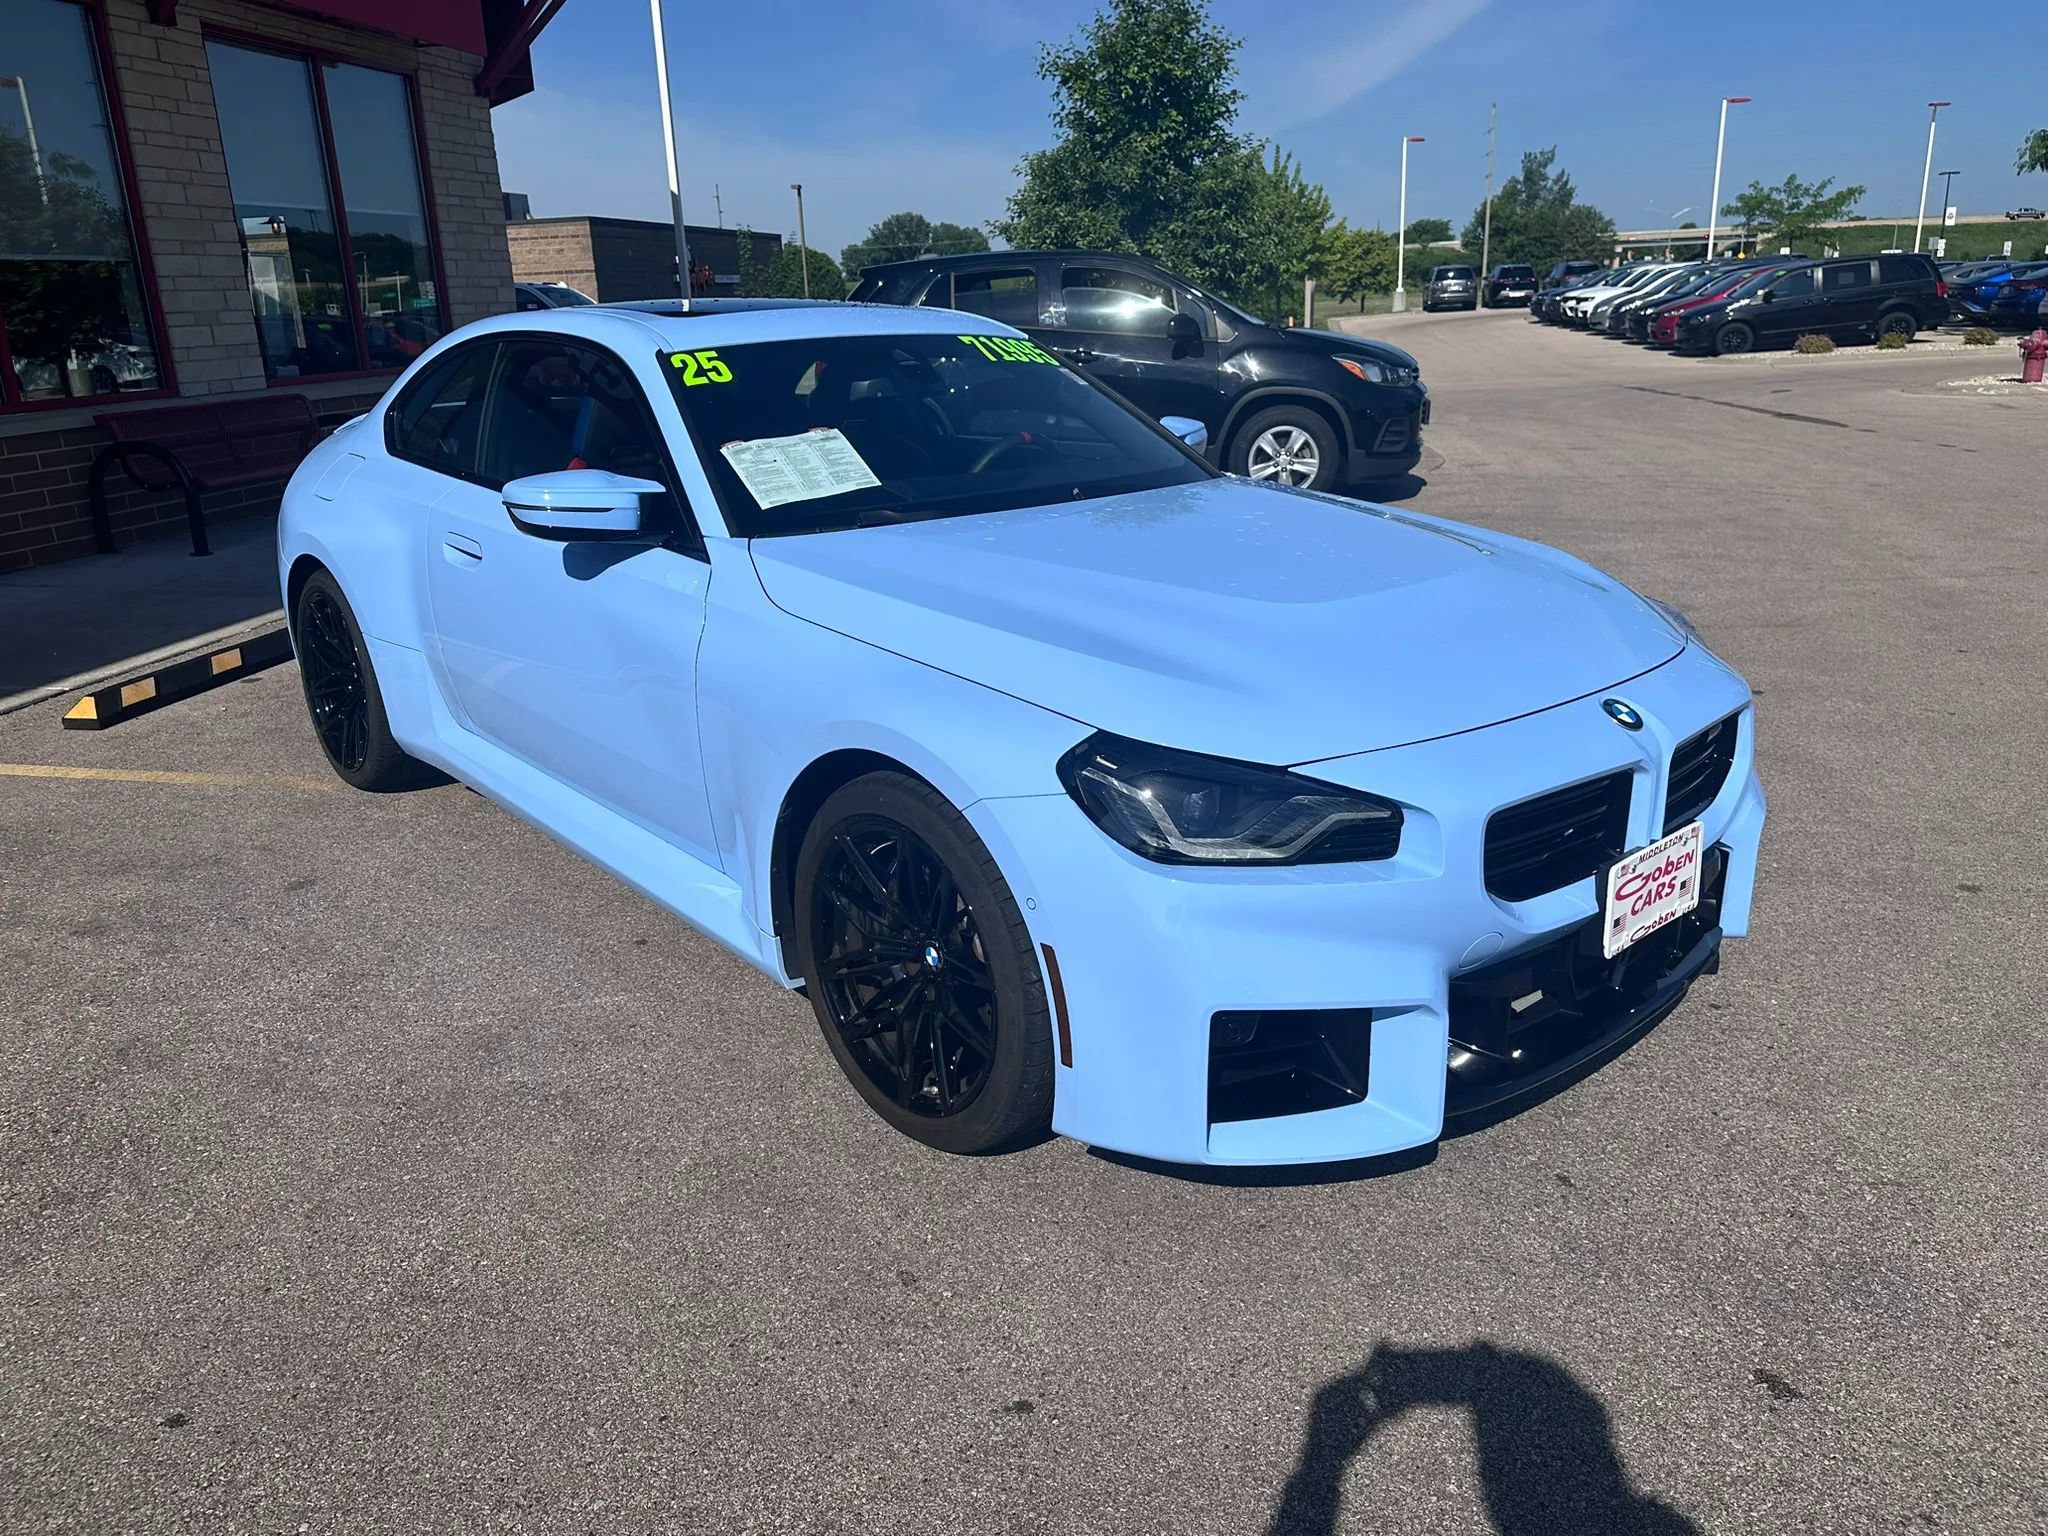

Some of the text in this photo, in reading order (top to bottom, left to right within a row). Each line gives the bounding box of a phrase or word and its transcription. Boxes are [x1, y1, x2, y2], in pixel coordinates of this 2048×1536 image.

[957, 335, 1060, 366] 71995
[670, 350, 733, 387] 25
[1638, 832, 1684, 863] MIDDLETON
[1631, 875, 1678, 916] CARS
